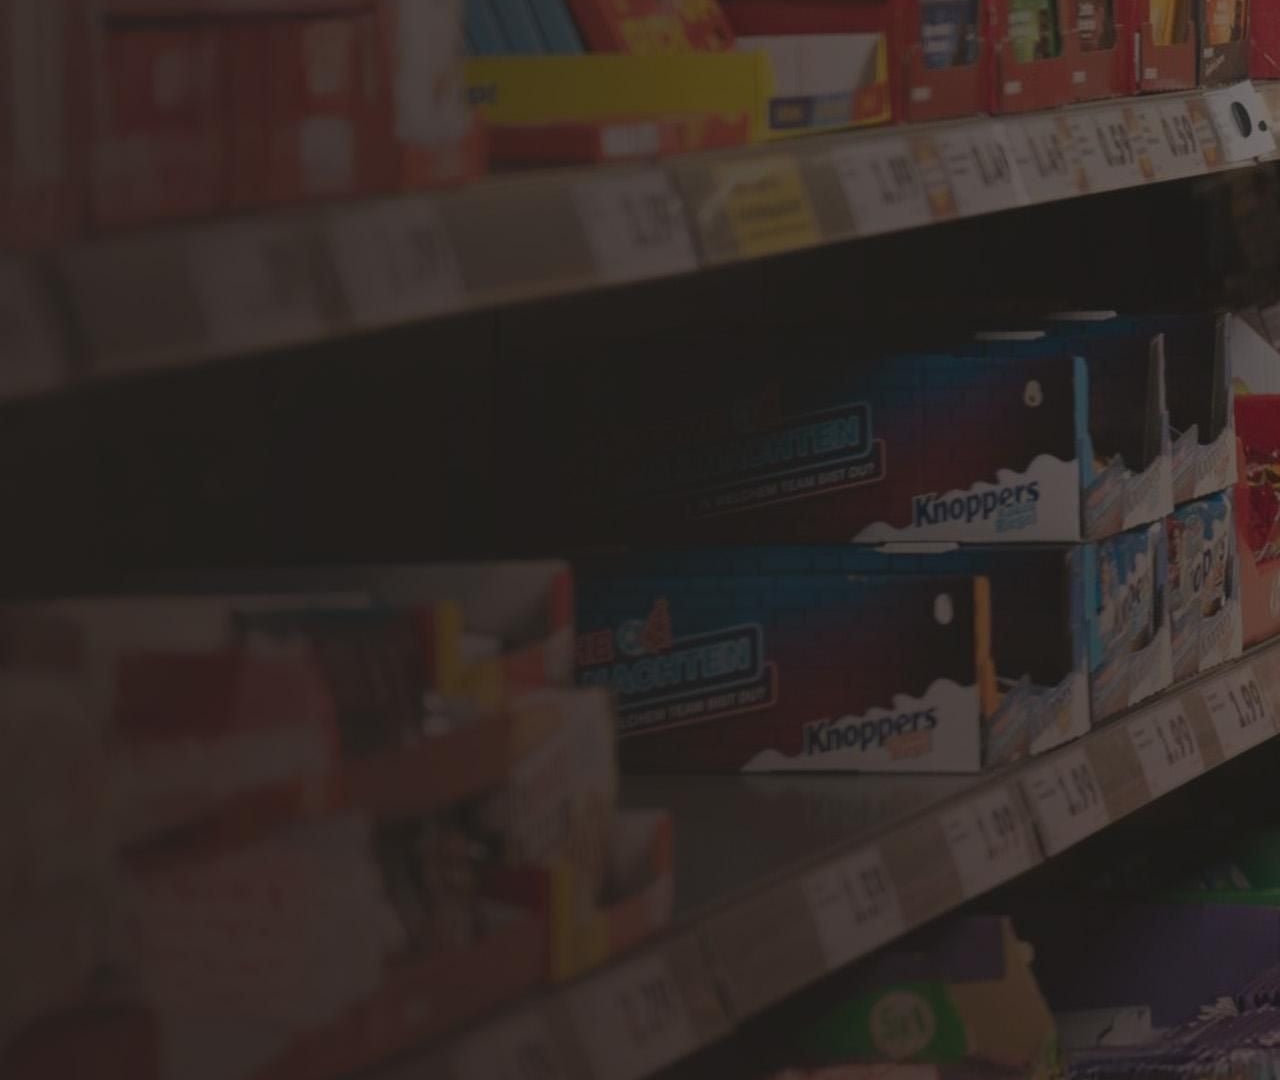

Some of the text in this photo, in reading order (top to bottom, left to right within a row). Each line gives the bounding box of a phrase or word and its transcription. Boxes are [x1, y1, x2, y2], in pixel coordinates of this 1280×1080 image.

[914, 481, 1040, 528] Knoppers
[1228, 679, 1265, 728] 1.99
[803, 706, 938, 756] Knoppers
[1156, 714, 1196, 767] 1.99
